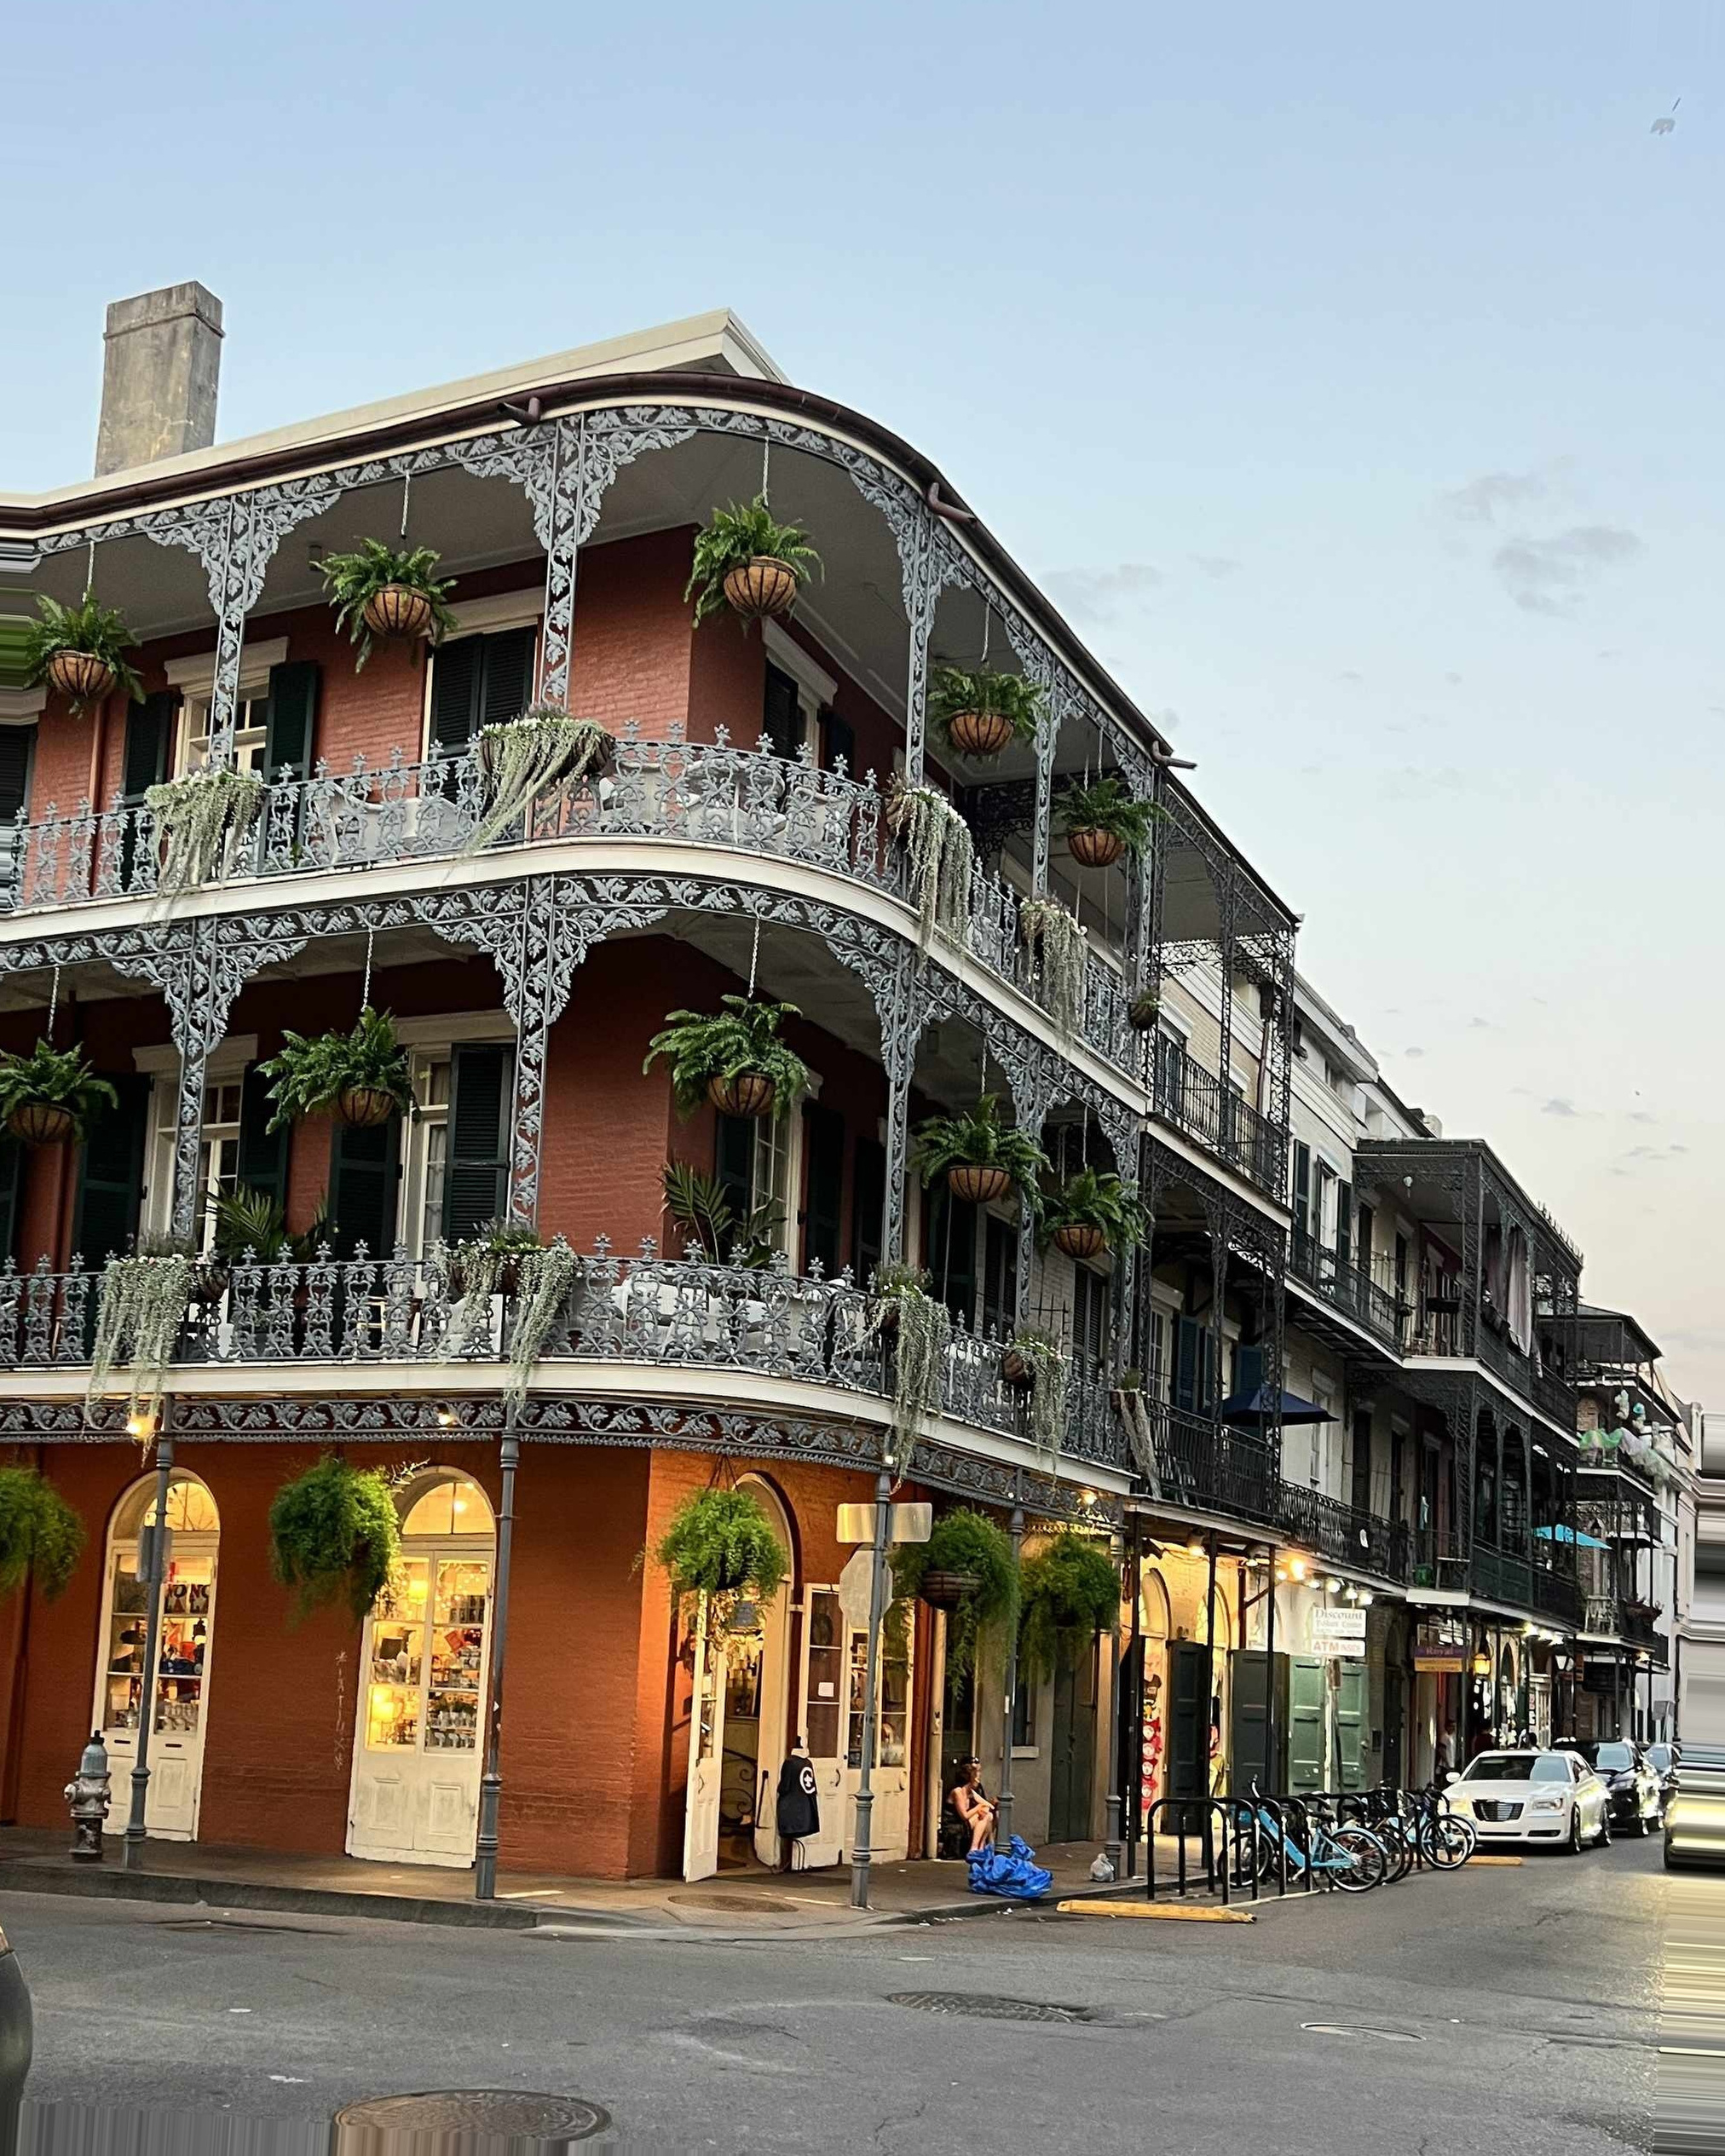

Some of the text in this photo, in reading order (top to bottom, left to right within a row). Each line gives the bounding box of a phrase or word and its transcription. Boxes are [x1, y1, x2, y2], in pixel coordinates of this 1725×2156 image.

[1315, 1609, 1363, 1619] Discount
[1313, 1640, 1339, 1652] ATM
[1426, 1646, 1454, 1656] Royal
